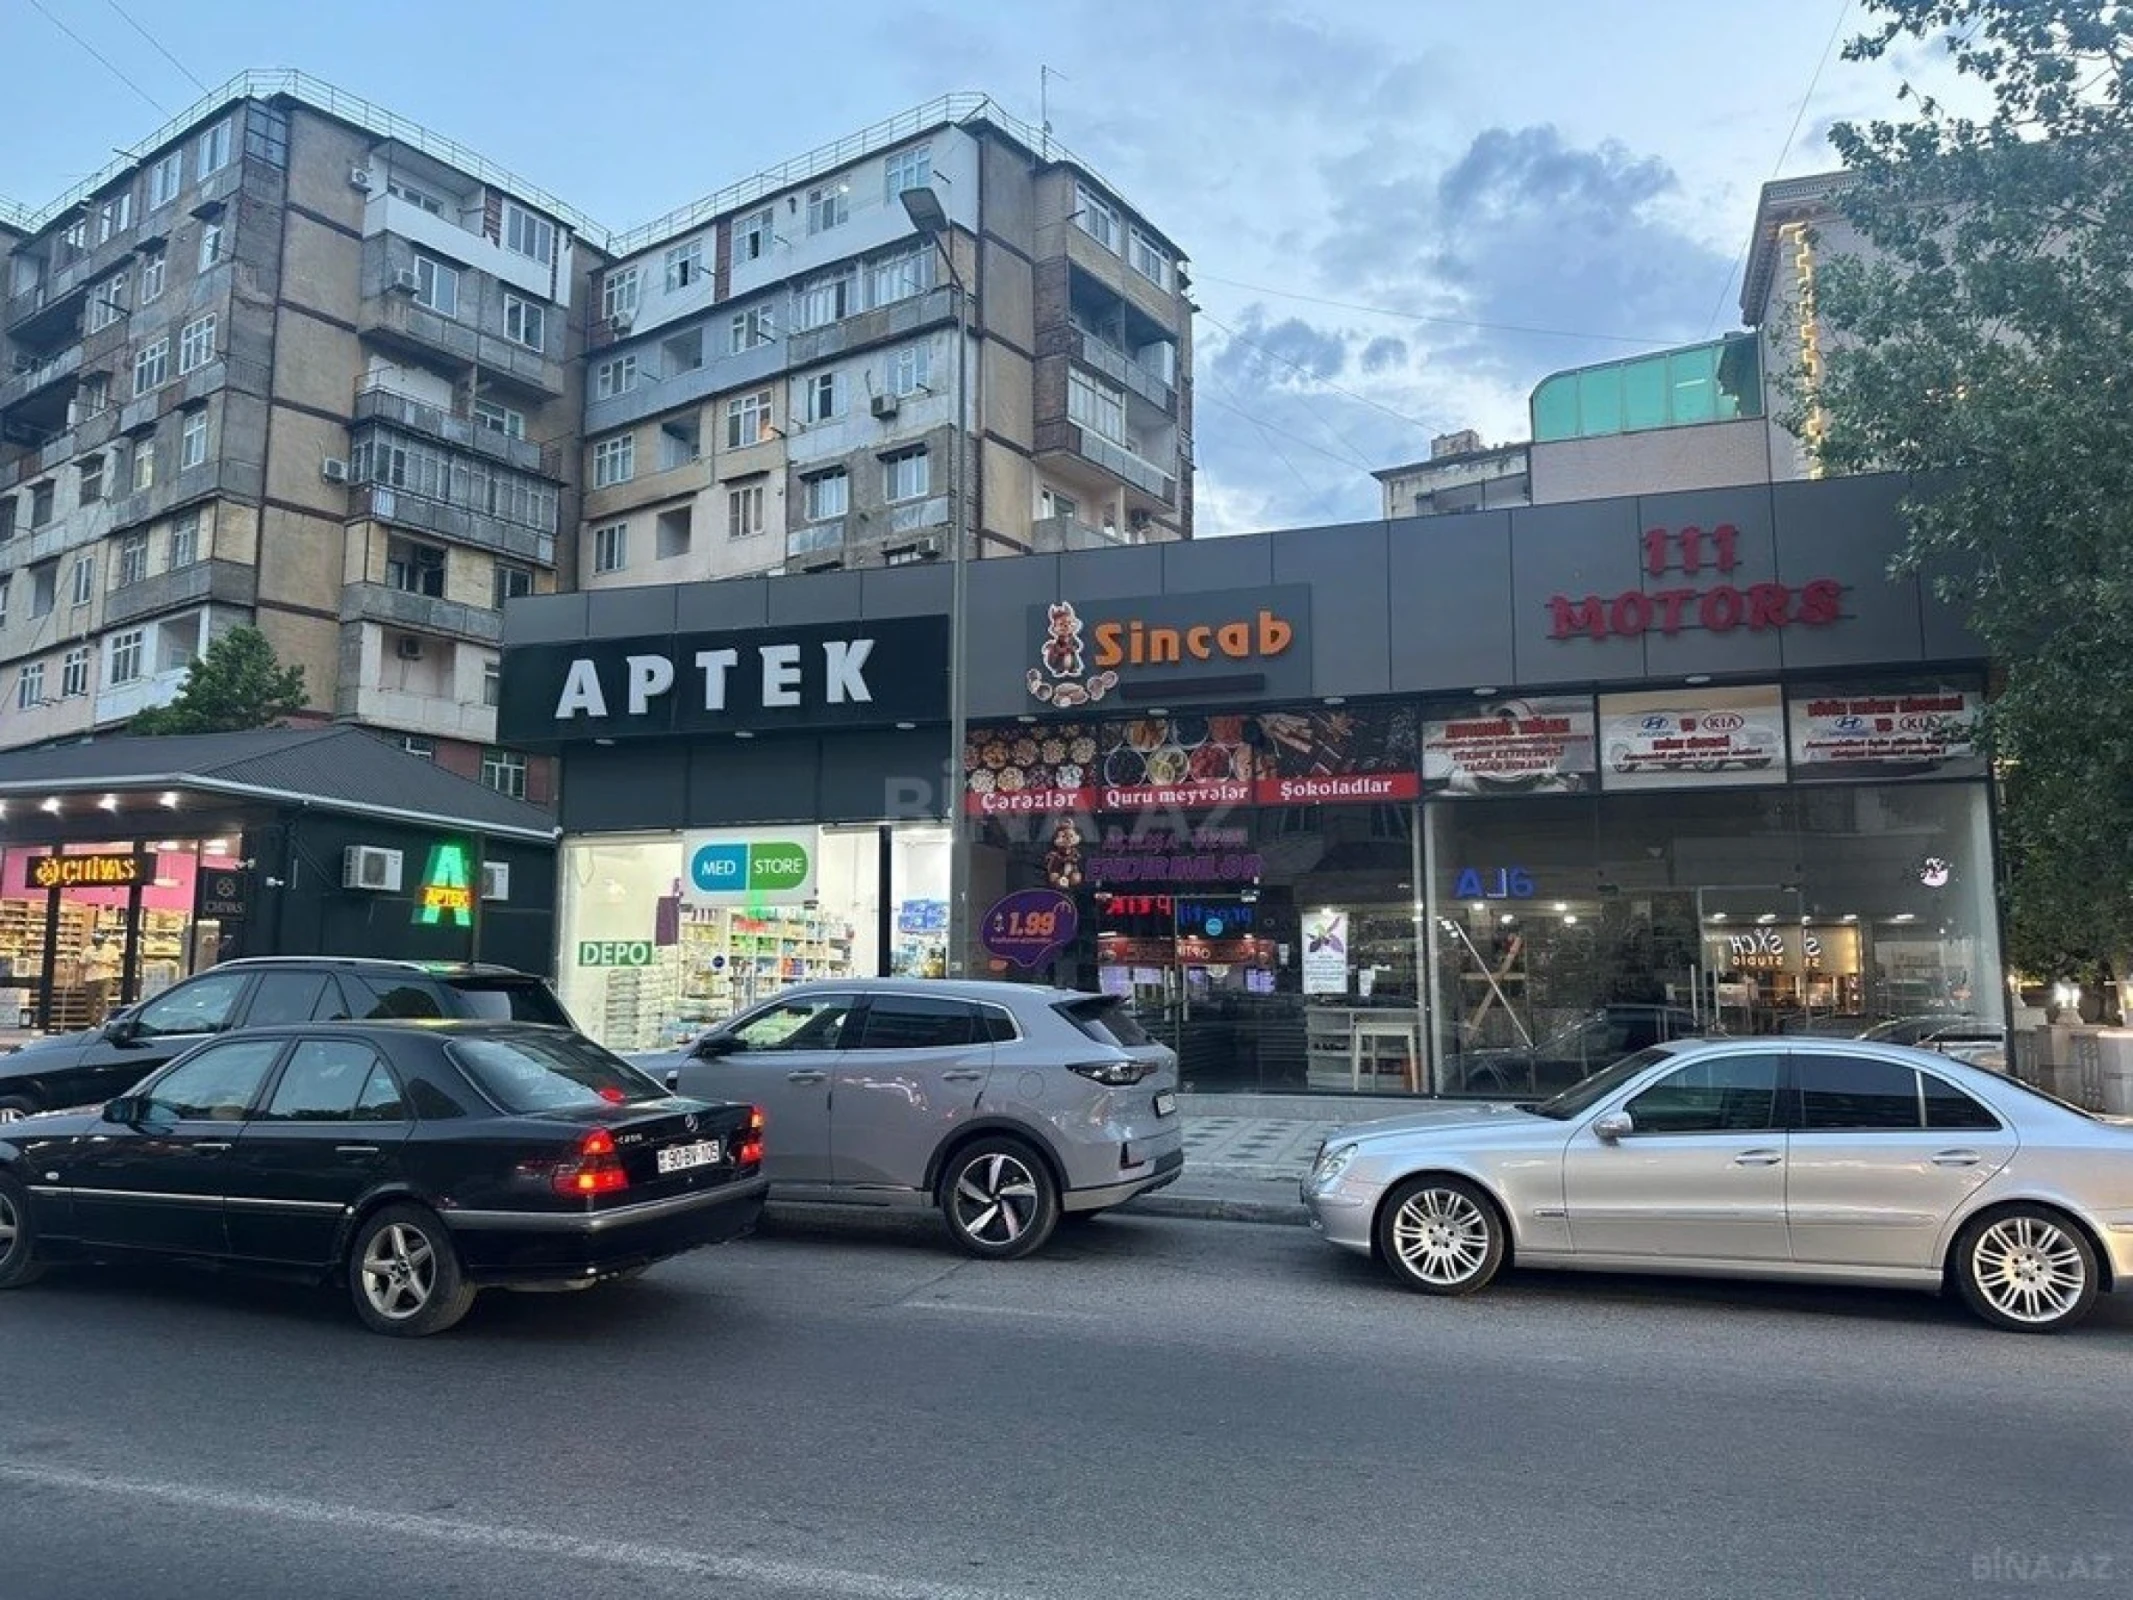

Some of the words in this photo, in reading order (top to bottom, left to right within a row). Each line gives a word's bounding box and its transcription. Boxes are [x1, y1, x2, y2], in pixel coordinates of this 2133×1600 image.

[1645, 524, 1738, 576] 111
[1550, 579, 1842, 640] MOTORS
[1095, 609, 1292, 667] Sincab
[555, 639, 875, 719] APTEK
[981, 789, 1078, 811] Çərəzlər
[1106, 790, 1153, 808] Quru
[1159, 786, 1248, 807] meyvələr
[1280, 779, 1392, 800] Şokoladlar
[701, 859, 736, 876] MED
[753, 857, 802, 875] STORE
[1009, 911, 1055, 936] 1.99
[582, 943, 650, 965] DEPO
